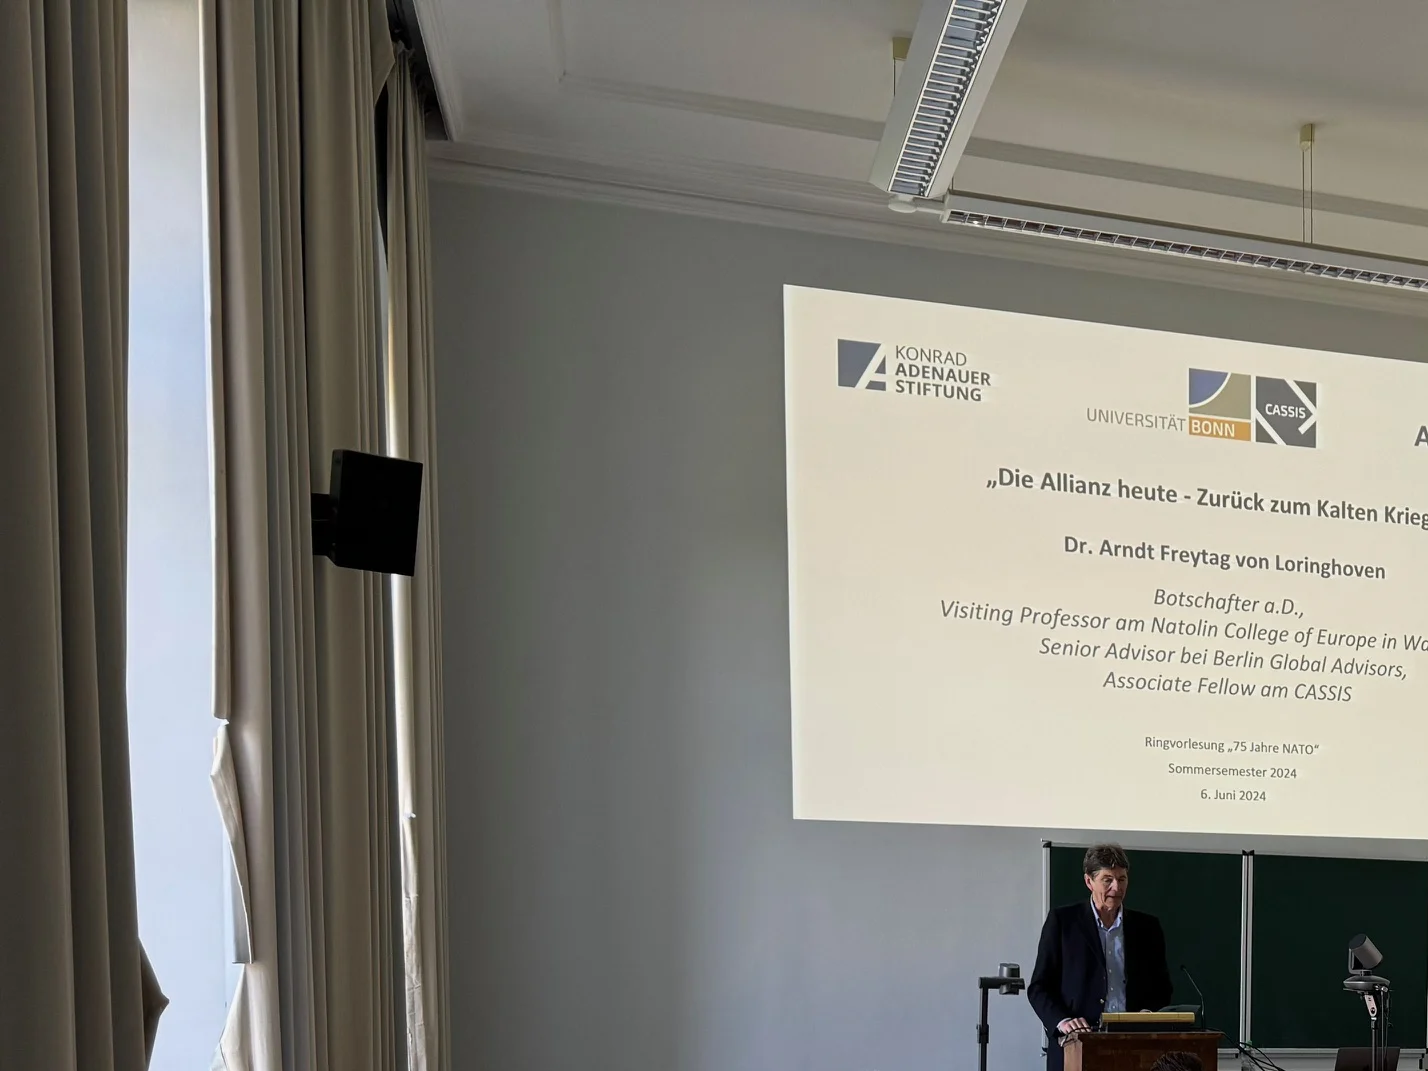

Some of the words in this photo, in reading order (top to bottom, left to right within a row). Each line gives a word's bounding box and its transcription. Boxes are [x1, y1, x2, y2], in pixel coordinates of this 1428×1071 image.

[895, 345, 967, 367] KONRAD
[895, 362, 992, 387] ADENAUER
[895, 379, 983, 402] STIFTUNG
[1086, 407, 1187, 432] UNIVERSITÄT
[1191, 420, 1236, 438] BONN
[1265, 403, 1307, 419] CASSIS
[986, 467, 1034, 489] „Die
[1040, 472, 1112, 497] Allianz
[1117, 478, 1178, 503] heute
[1196, 487, 1265, 512] Zurück
[1270, 499, 1311, 516] zum
[1317, 499, 1378, 523] Kalten
[1064, 535, 1093, 555] Dr.
[1098, 539, 1155, 561] Arndt
[1161, 544, 1231, 571] Freytag
[1235, 554, 1270, 570] von
[1275, 554, 1386, 580] Loringhoven
[1153, 588, 1260, 615] Botschafter
[1264, 598, 1304, 620] a.D.,
[940, 599, 1014, 627] Visiting
[1019, 606, 1111, 630] Professor
[1115, 617, 1145, 633] am
[1150, 616, 1218, 638] Natolin
[1224, 622, 1289, 646] College
[1294, 626, 1315, 648] of
[1316, 628, 1378, 652] Europe
[1381, 632, 1397, 650] in
[1038, 637, 1101, 658] Senior
[1104, 642, 1176, 663] Advisor
[1180, 646, 1208, 665] bei
[1213, 648, 1264, 669] Berlin
[1269, 653, 1327, 673] Global
[1330, 657, 1407, 681] Advisors,
[1102, 671, 1192, 693] Associate
[1197, 677, 1257, 697] Fellow
[1260, 684, 1289, 699] am
[1294, 683, 1353, 702] CASSIS
[1145, 736, 1225, 754] Ringvorlesung
[1249, 741, 1280, 754] Jahre
[1168, 762, 1268, 778] Sommersemester
[1270, 767, 1298, 779] 2024
[1200, 788, 1211, 800] 6.
[1213, 789, 1236, 801] Juni
[1238, 789, 1267, 802] 2024
